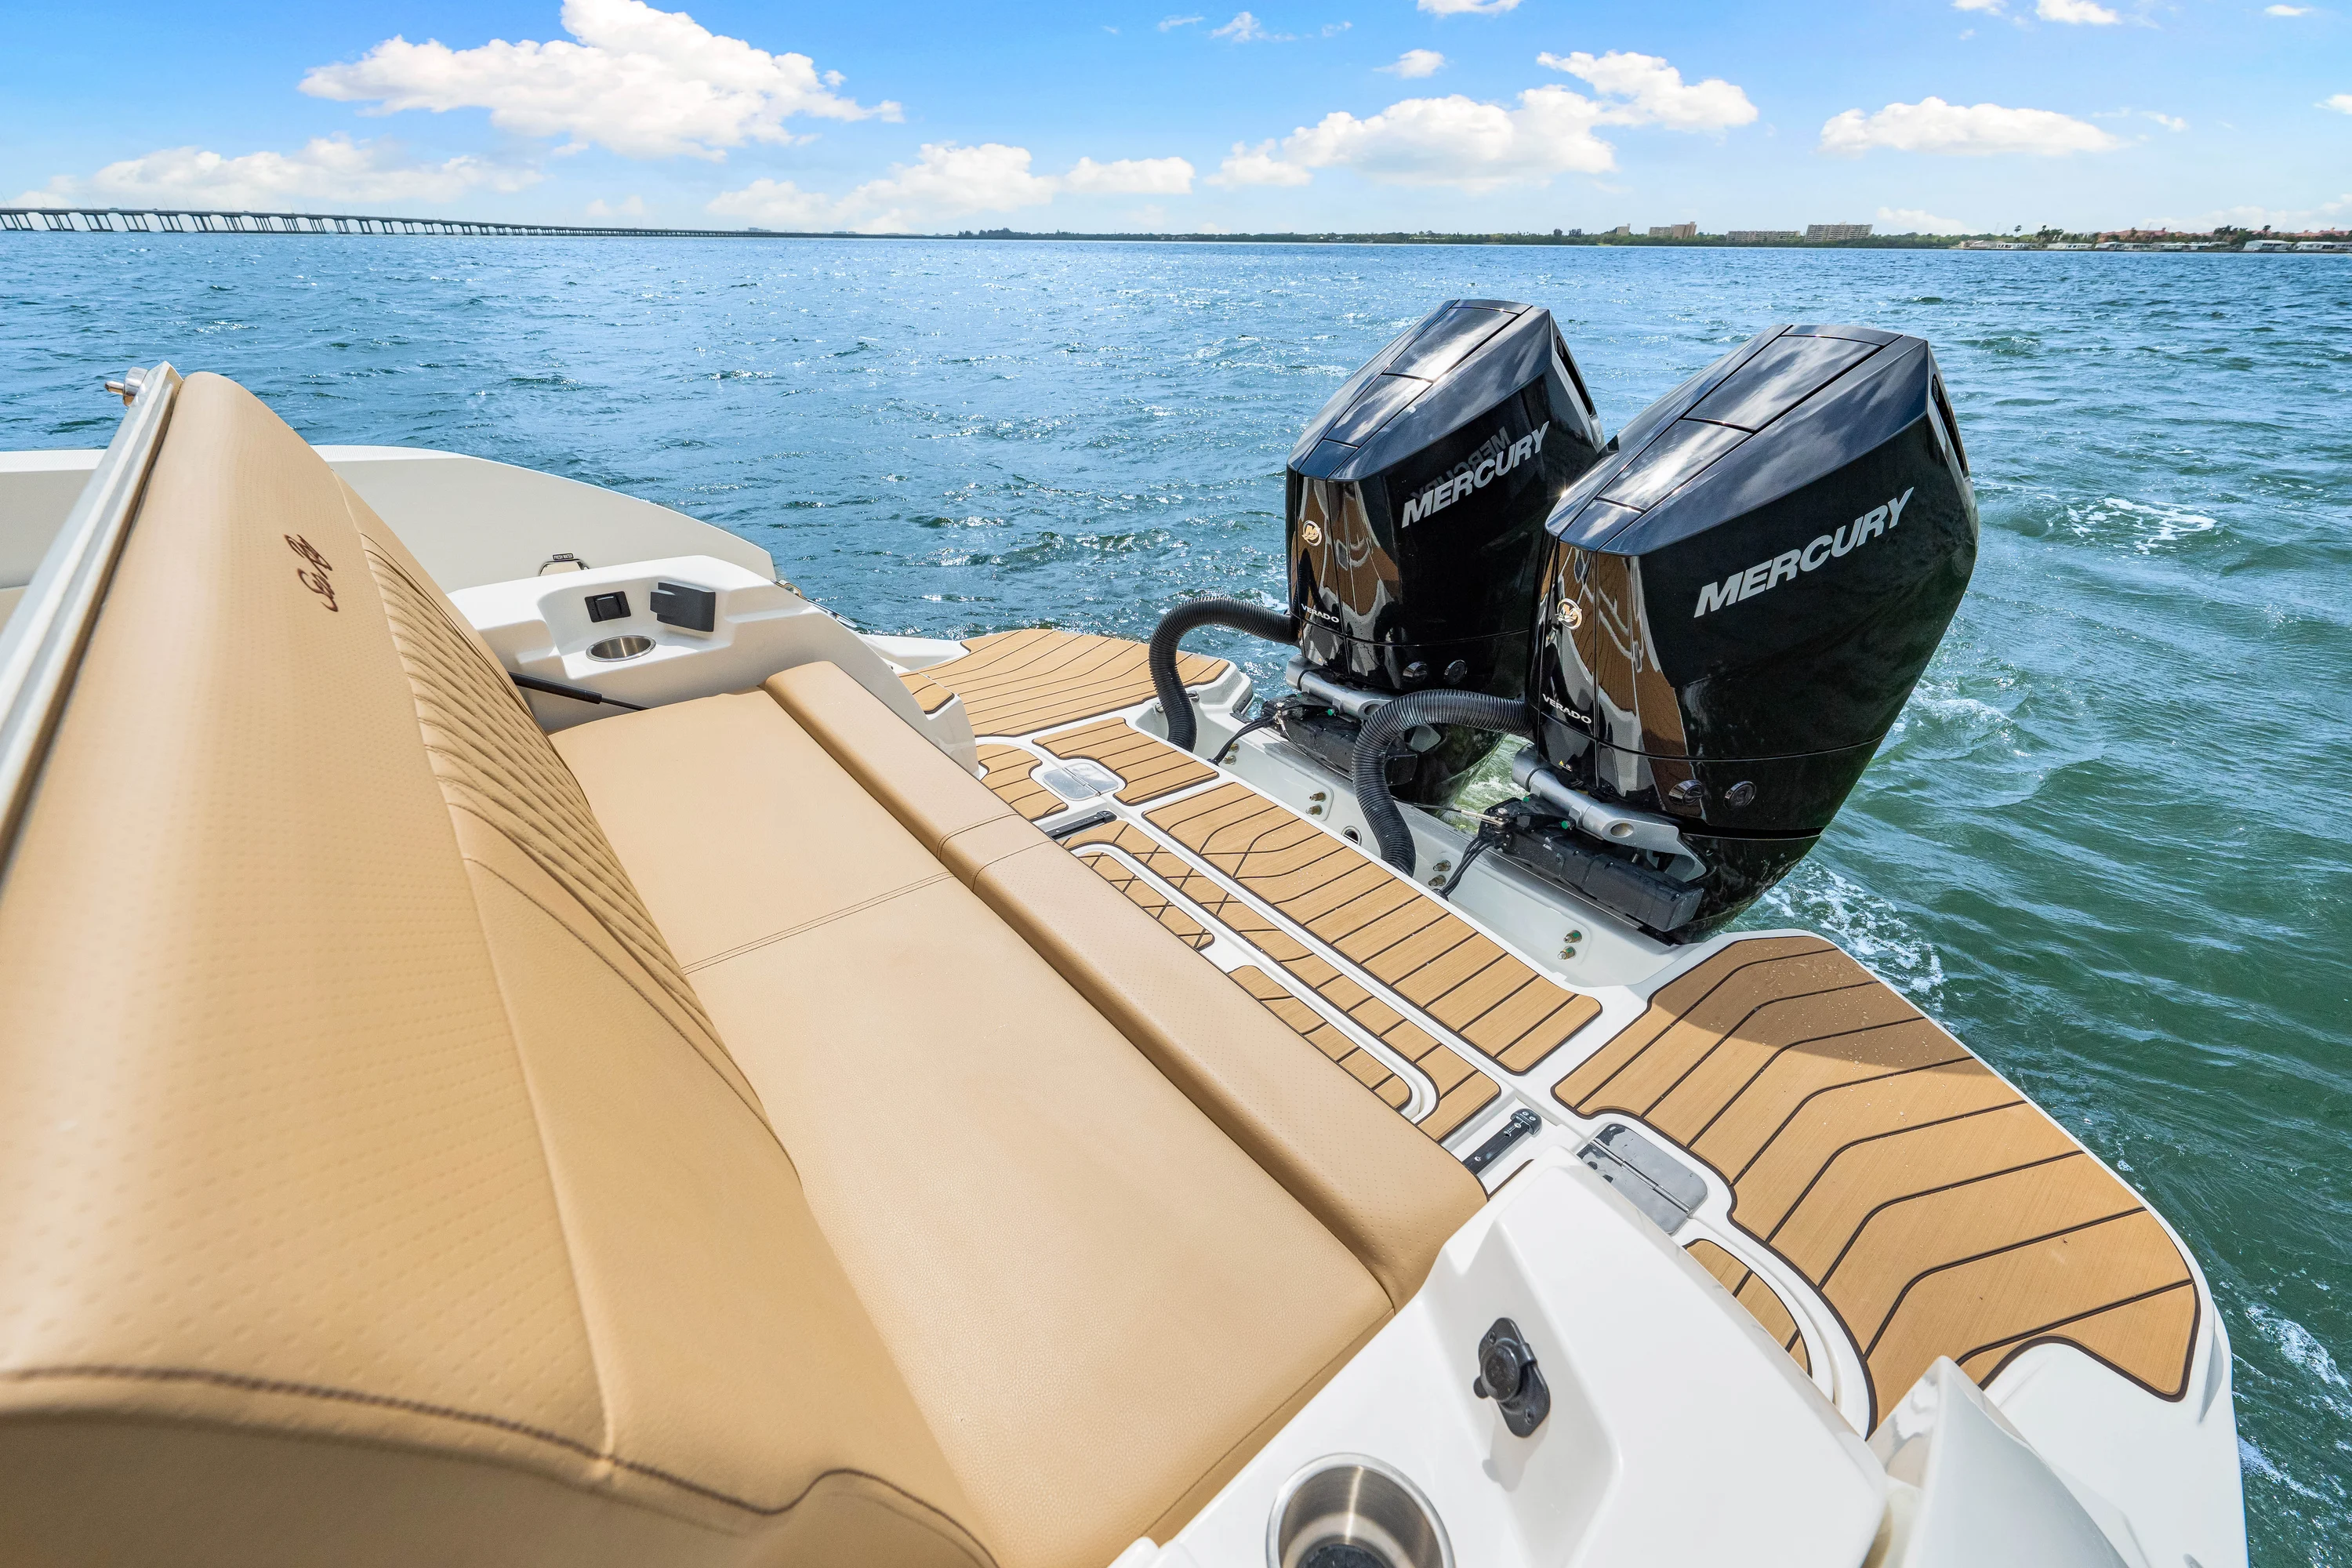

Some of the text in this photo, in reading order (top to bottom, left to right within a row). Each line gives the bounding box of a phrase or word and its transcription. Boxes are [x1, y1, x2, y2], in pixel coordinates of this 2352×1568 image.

[1402, 421, 1549, 528] MERCURY
[1693, 487, 1914, 618] MERCURY
[1301, 604, 1339, 622] VERADO
[1542, 693, 1592, 724] VERADO
